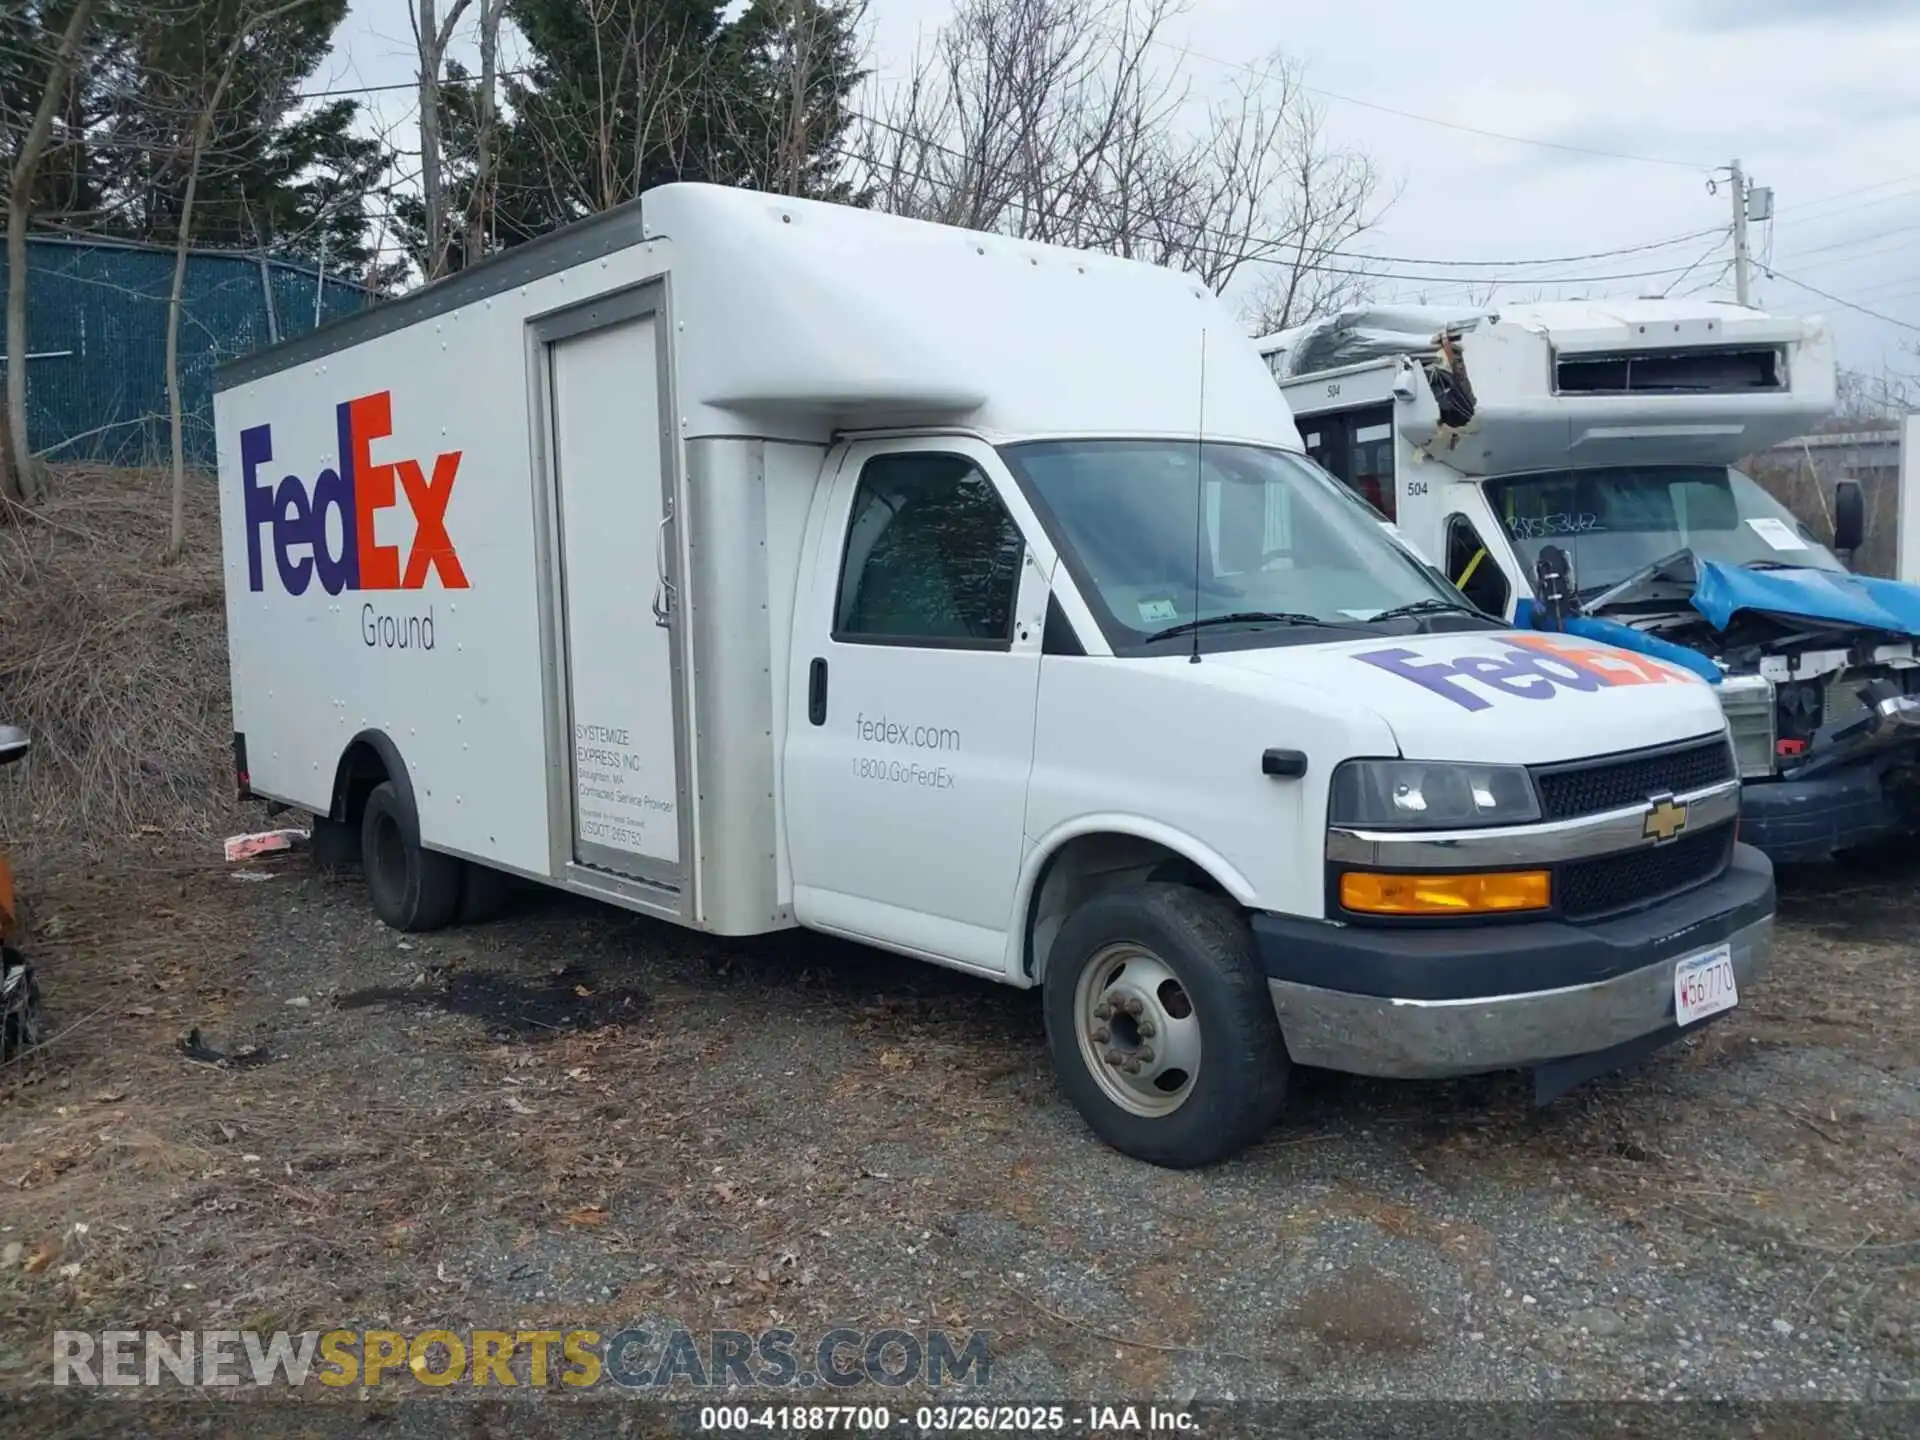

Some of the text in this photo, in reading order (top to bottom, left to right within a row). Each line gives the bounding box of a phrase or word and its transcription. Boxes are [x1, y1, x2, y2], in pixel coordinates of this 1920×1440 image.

[1327, 384, 1341, 399] 504
[240, 390, 472, 596] FedEx
[1407, 482, 1428, 496] 504
[361, 602, 435, 651] Ground
[1348, 636, 1694, 713] FedEx
[576, 723, 630, 746] SYSTEMIZE
[856, 711, 961, 751] fedex.com
[577, 745, 621, 768] EXPRESS
[852, 757, 956, 789] 1.800.GoFedEx
